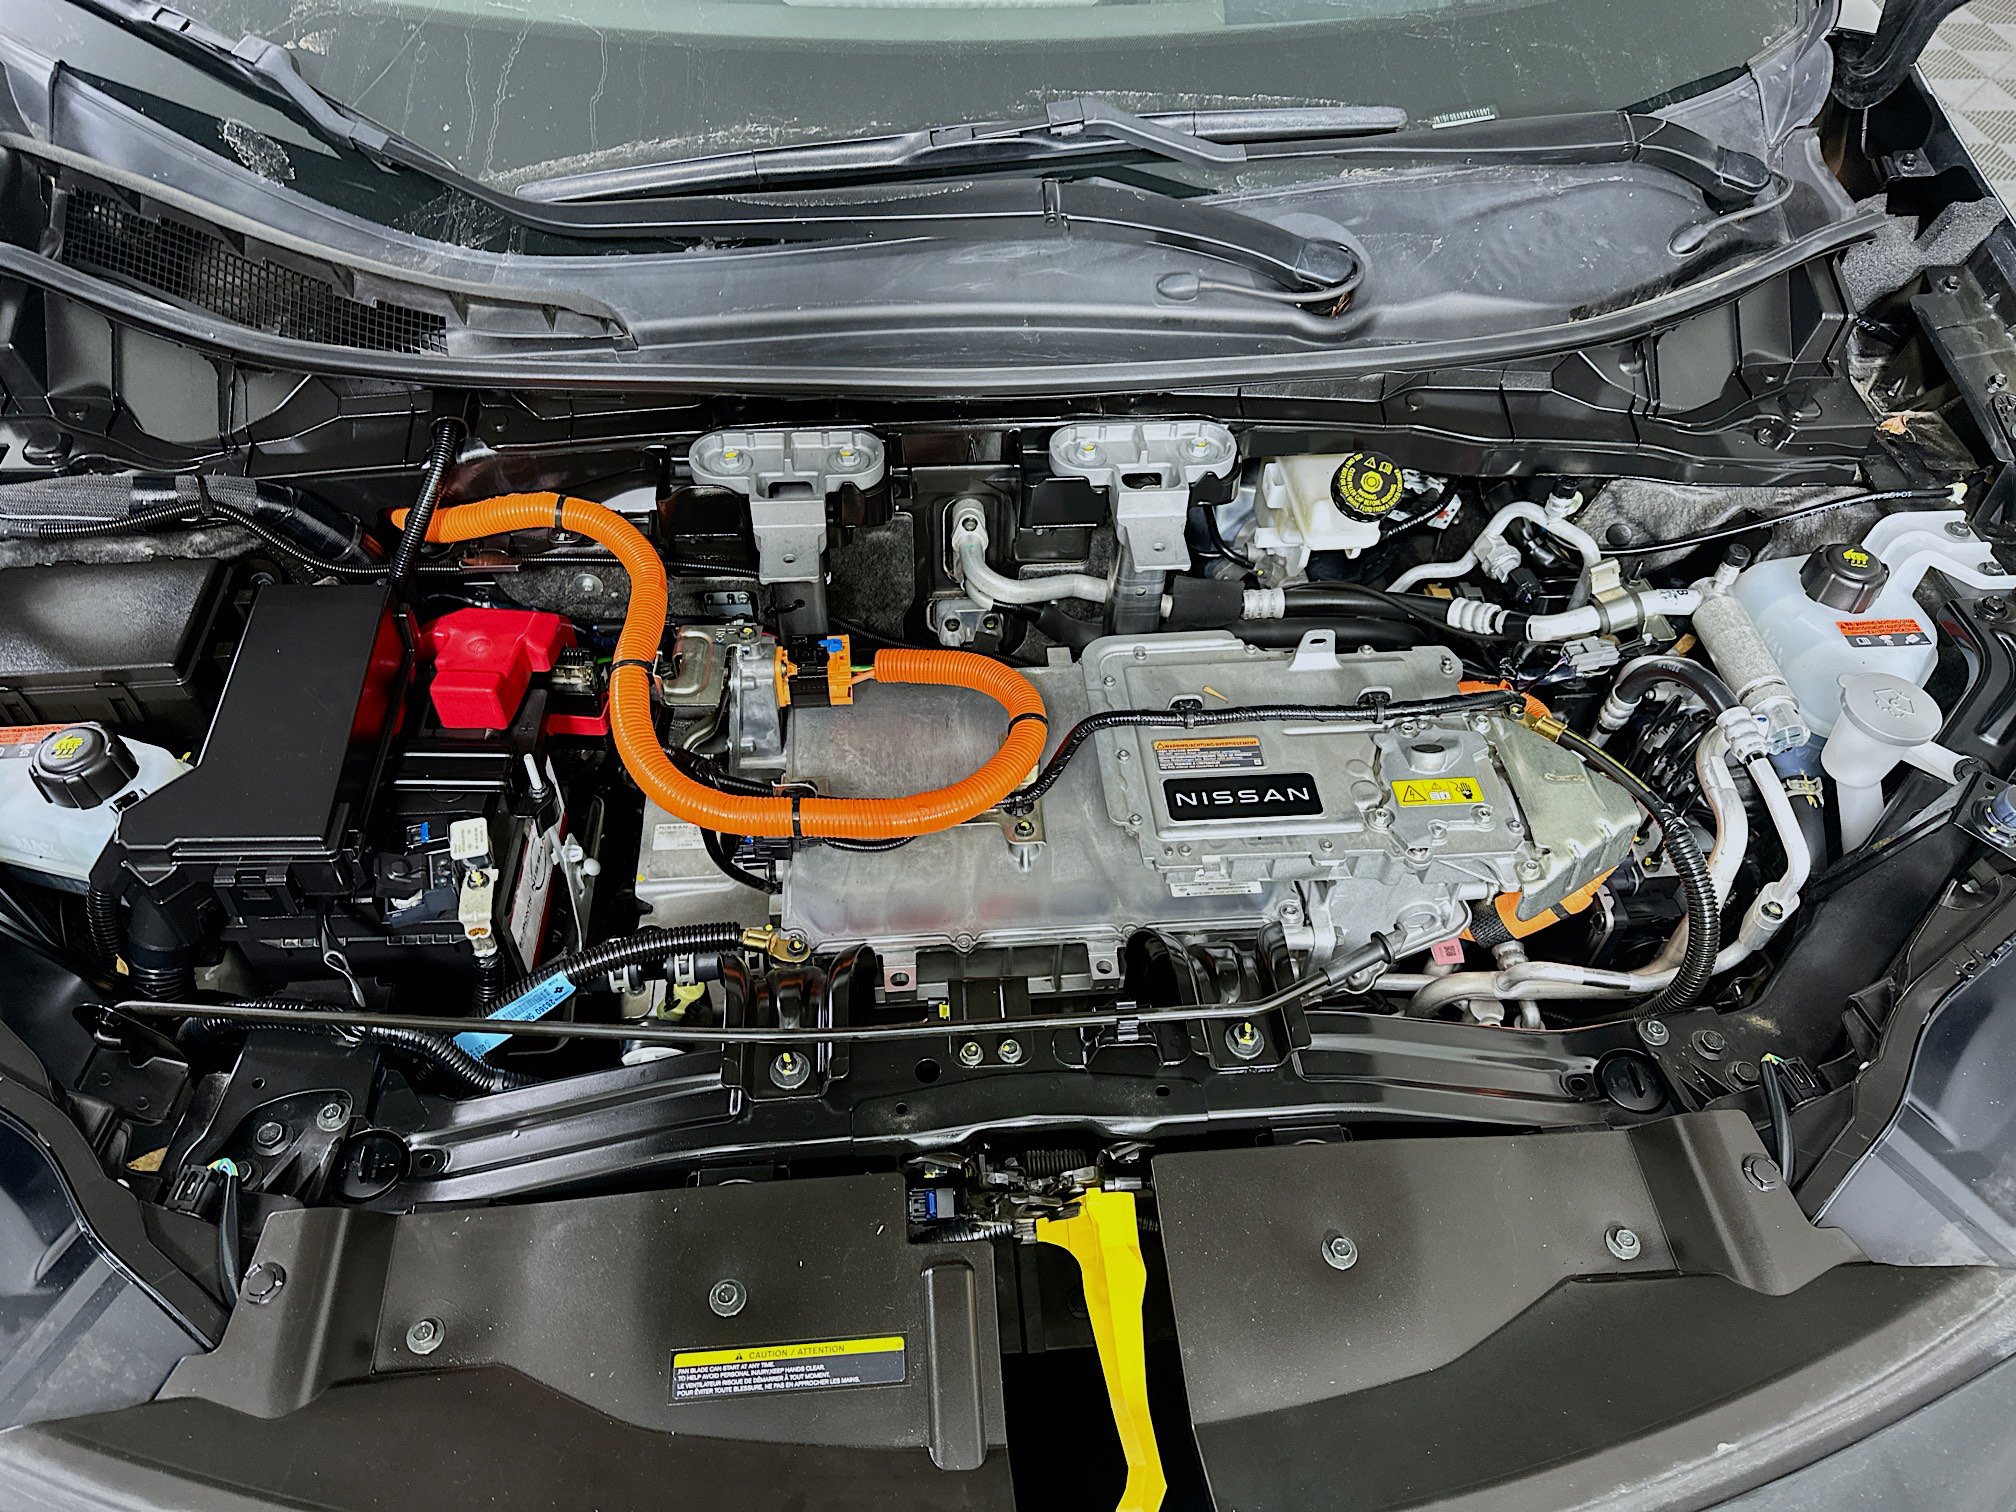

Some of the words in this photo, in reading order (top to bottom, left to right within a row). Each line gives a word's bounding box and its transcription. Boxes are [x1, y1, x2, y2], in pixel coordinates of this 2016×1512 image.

[1360, 504, 1372, 512] FLUID
[1175, 787, 1311, 807] NISSAN
[749, 1348, 790, 1360] CAUTION
[798, 1345, 845, 1356] ATTENTION
[720, 1370, 749, 1378] PERSONAL
[794, 1380, 829, 1388] APPROCHER
